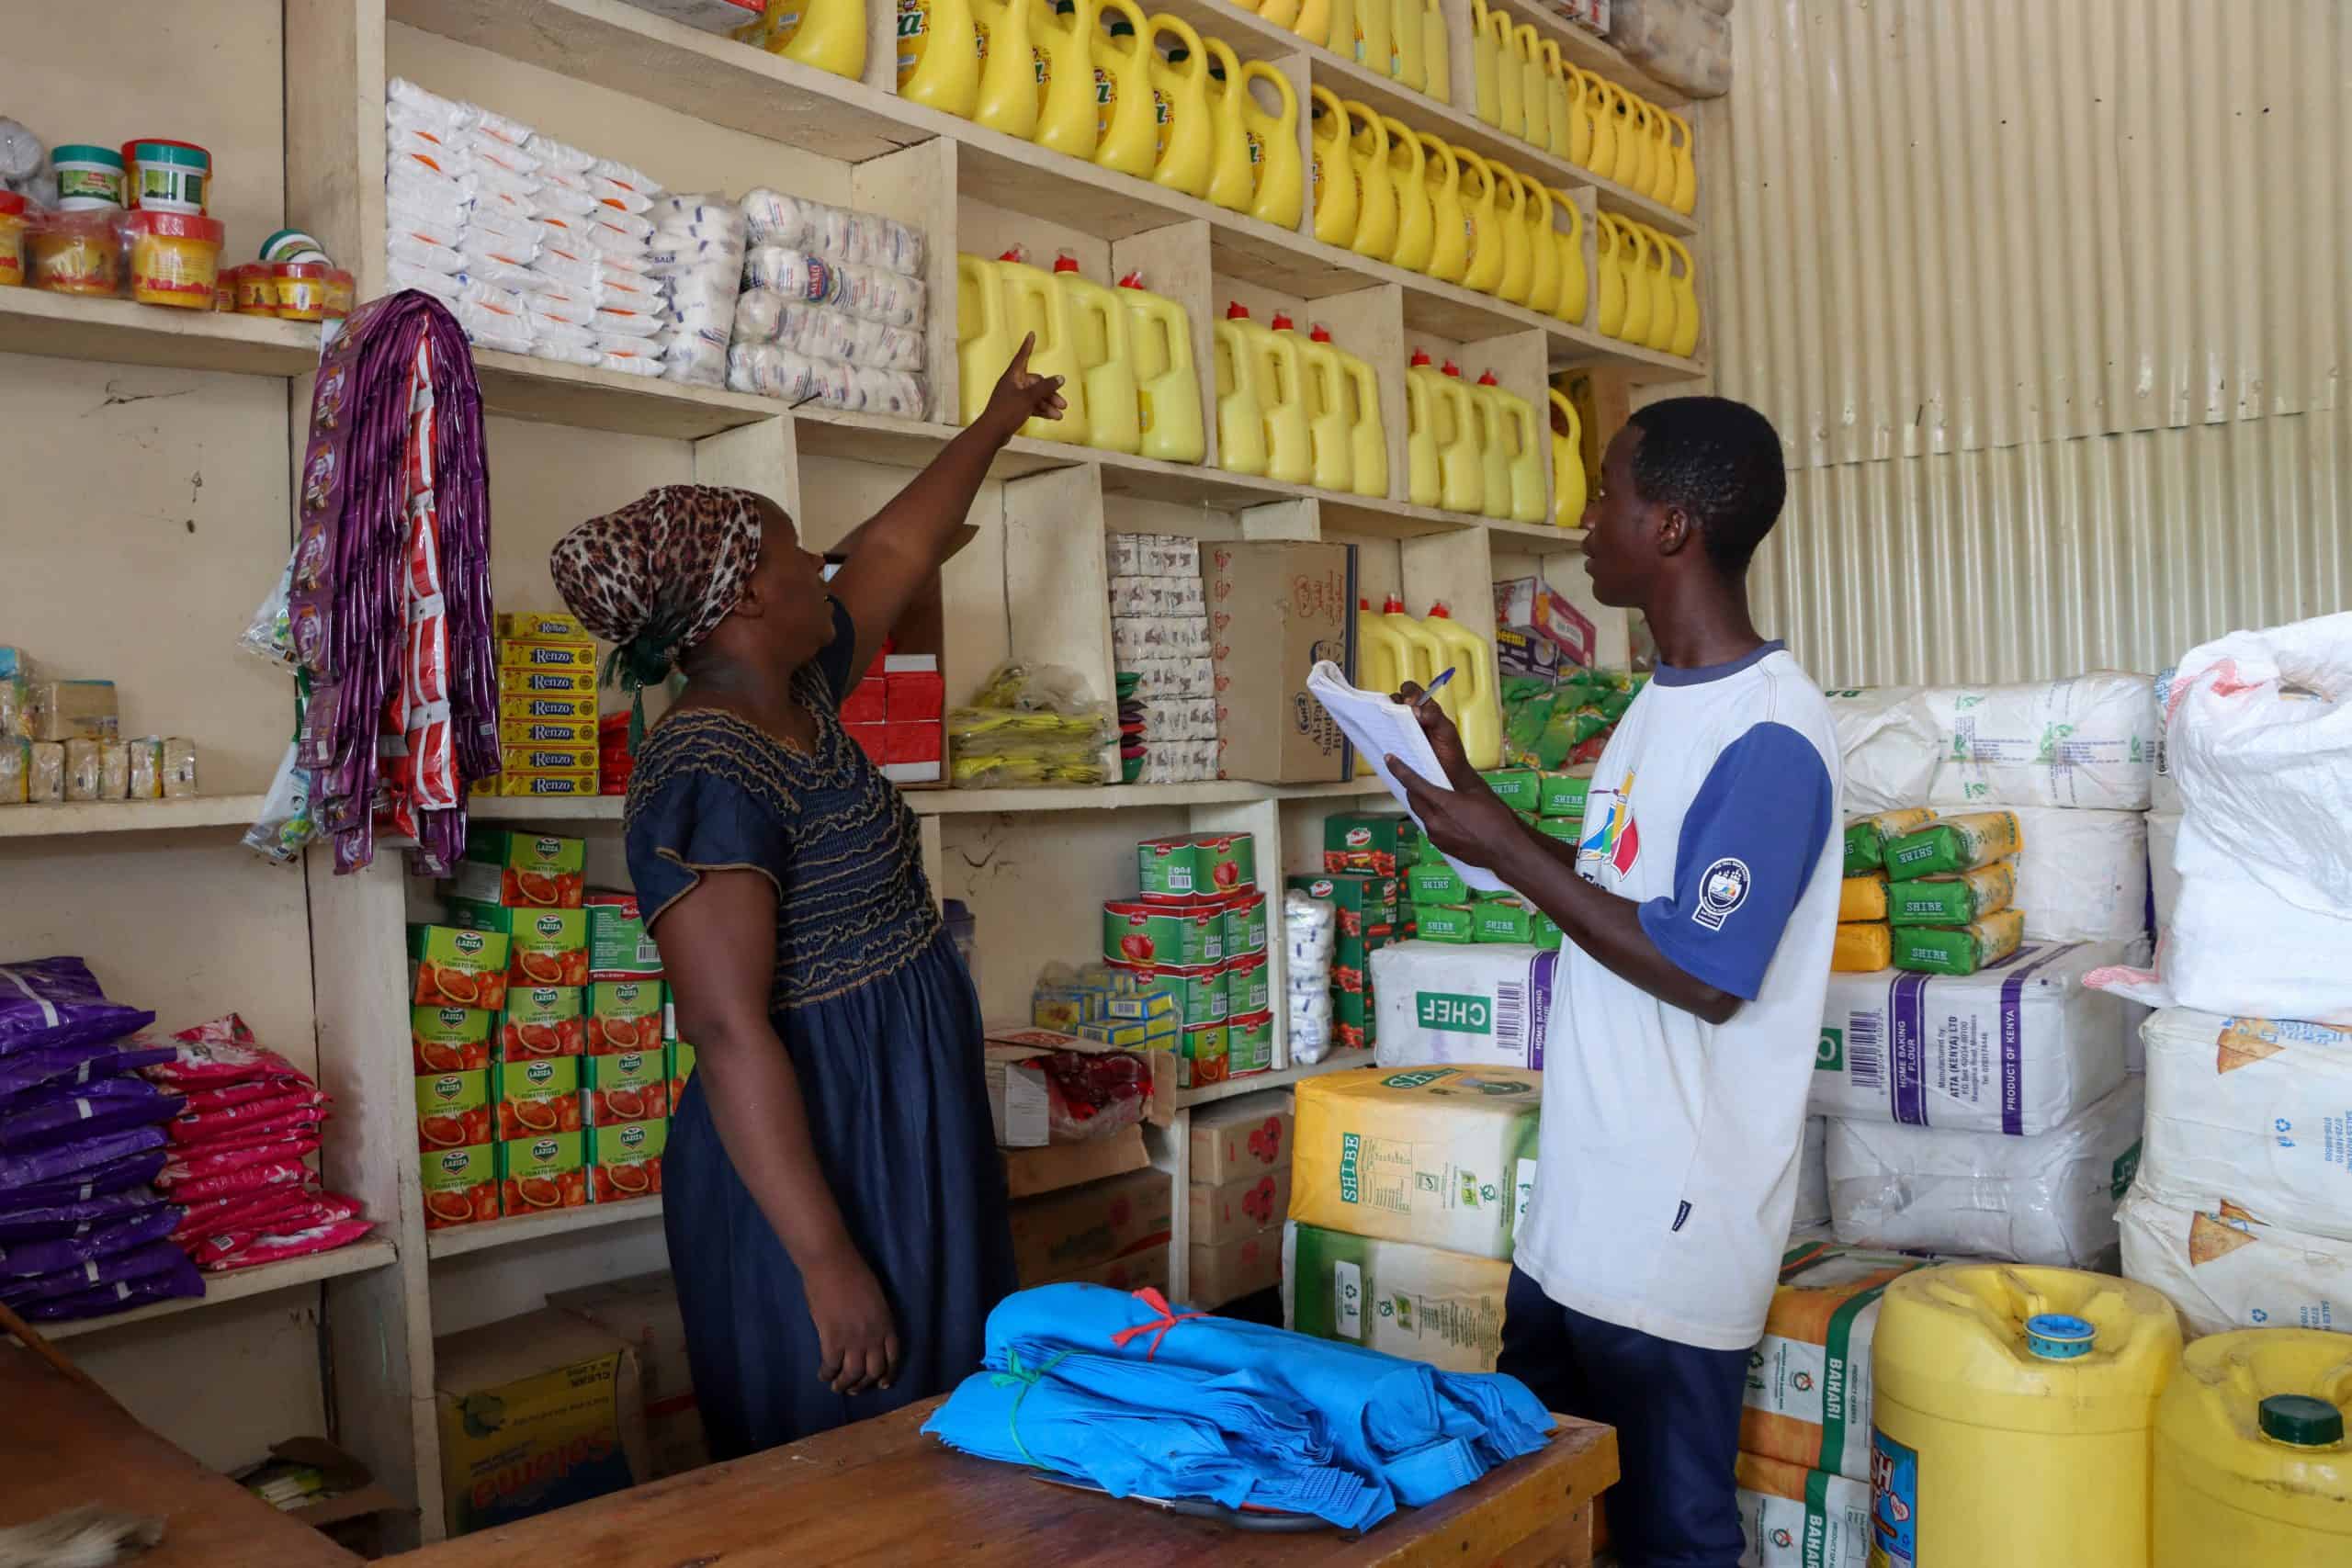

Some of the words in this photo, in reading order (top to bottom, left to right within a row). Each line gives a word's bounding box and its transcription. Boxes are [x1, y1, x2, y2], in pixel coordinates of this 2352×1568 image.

[537, 649, 570, 663] Renzo
[535, 675, 570, 689] Renzo
[535, 700, 570, 715] Renzo
[535, 724, 570, 739] Renzo
[536, 751, 571, 766] Renzo
[537, 778, 571, 793] Renzo
[1906, 902, 1942, 912] SHIBE
[538, 921, 560, 931] LAZIZA
[457, 939, 481, 948] LAZIZA
[1422, 999, 1487, 1027] CHEF
[1949, 1017, 1958, 1033] LTD
[2006, 1010, 2015, 1043] KENYA
[1535, 1024, 1544, 1050] HOME
[1897, 1021, 1906, 1058] BAKING
[1907, 1039, 1916, 1072] FLOUR
[1938, 1039, 1946, 1089] Manufactured
[1948, 1036, 1960, 1074] (KENYA)
[2007, 1047, 2016, 1060] OF
[1898, 1062, 1907, 1089] HOME
[1949, 1076, 1960, 1098] ATTA
[2007, 1064, 2016, 1111] PRODUCT
[443, 1159, 468, 1168] LAZIZA
[1343, 1135, 1360, 1202] SHIBE
[1827, 1358, 1843, 1419] BAHARI
[1807, 1515, 1823, 1568] BAHAR
